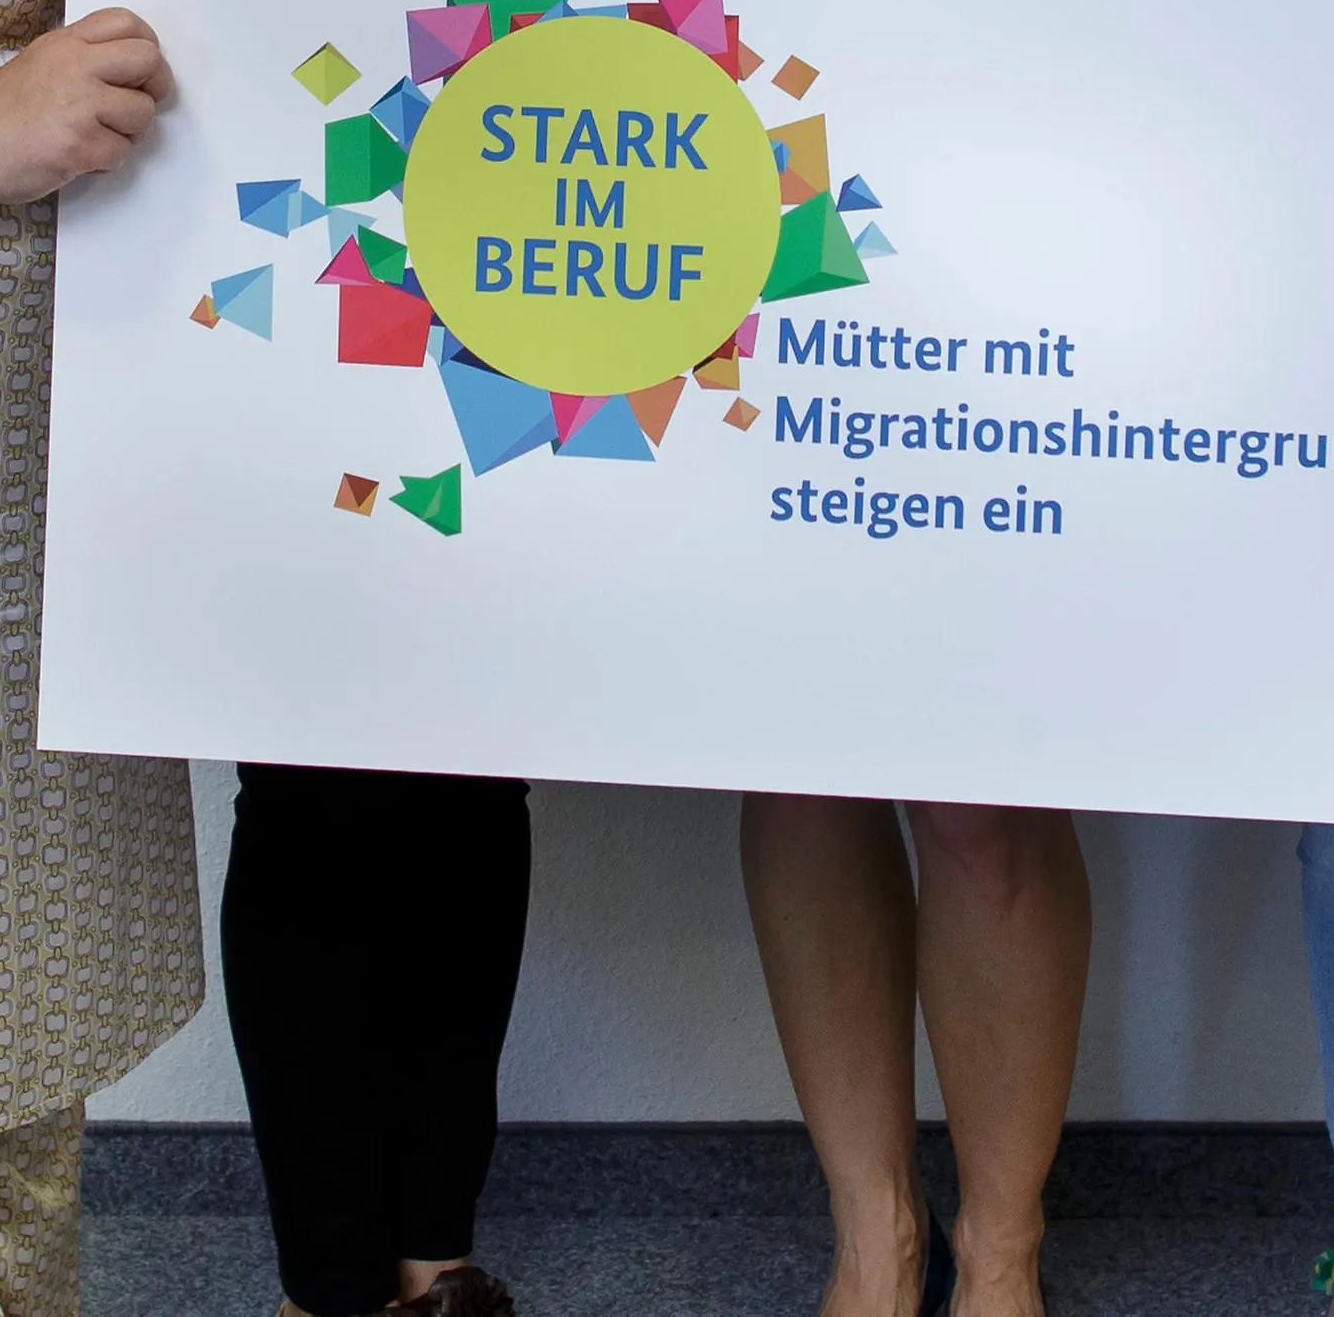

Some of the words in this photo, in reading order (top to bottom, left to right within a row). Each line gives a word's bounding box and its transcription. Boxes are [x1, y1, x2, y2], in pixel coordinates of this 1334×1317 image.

[481, 104, 709, 170] STARK
[555, 178, 625, 229] IM
[475, 236, 704, 301] BERUF
[777, 317, 968, 373] Mütter
[983, 328, 1075, 378] mit
[770, 477, 965, 540] steigen
[982, 485, 1064, 534] ein
